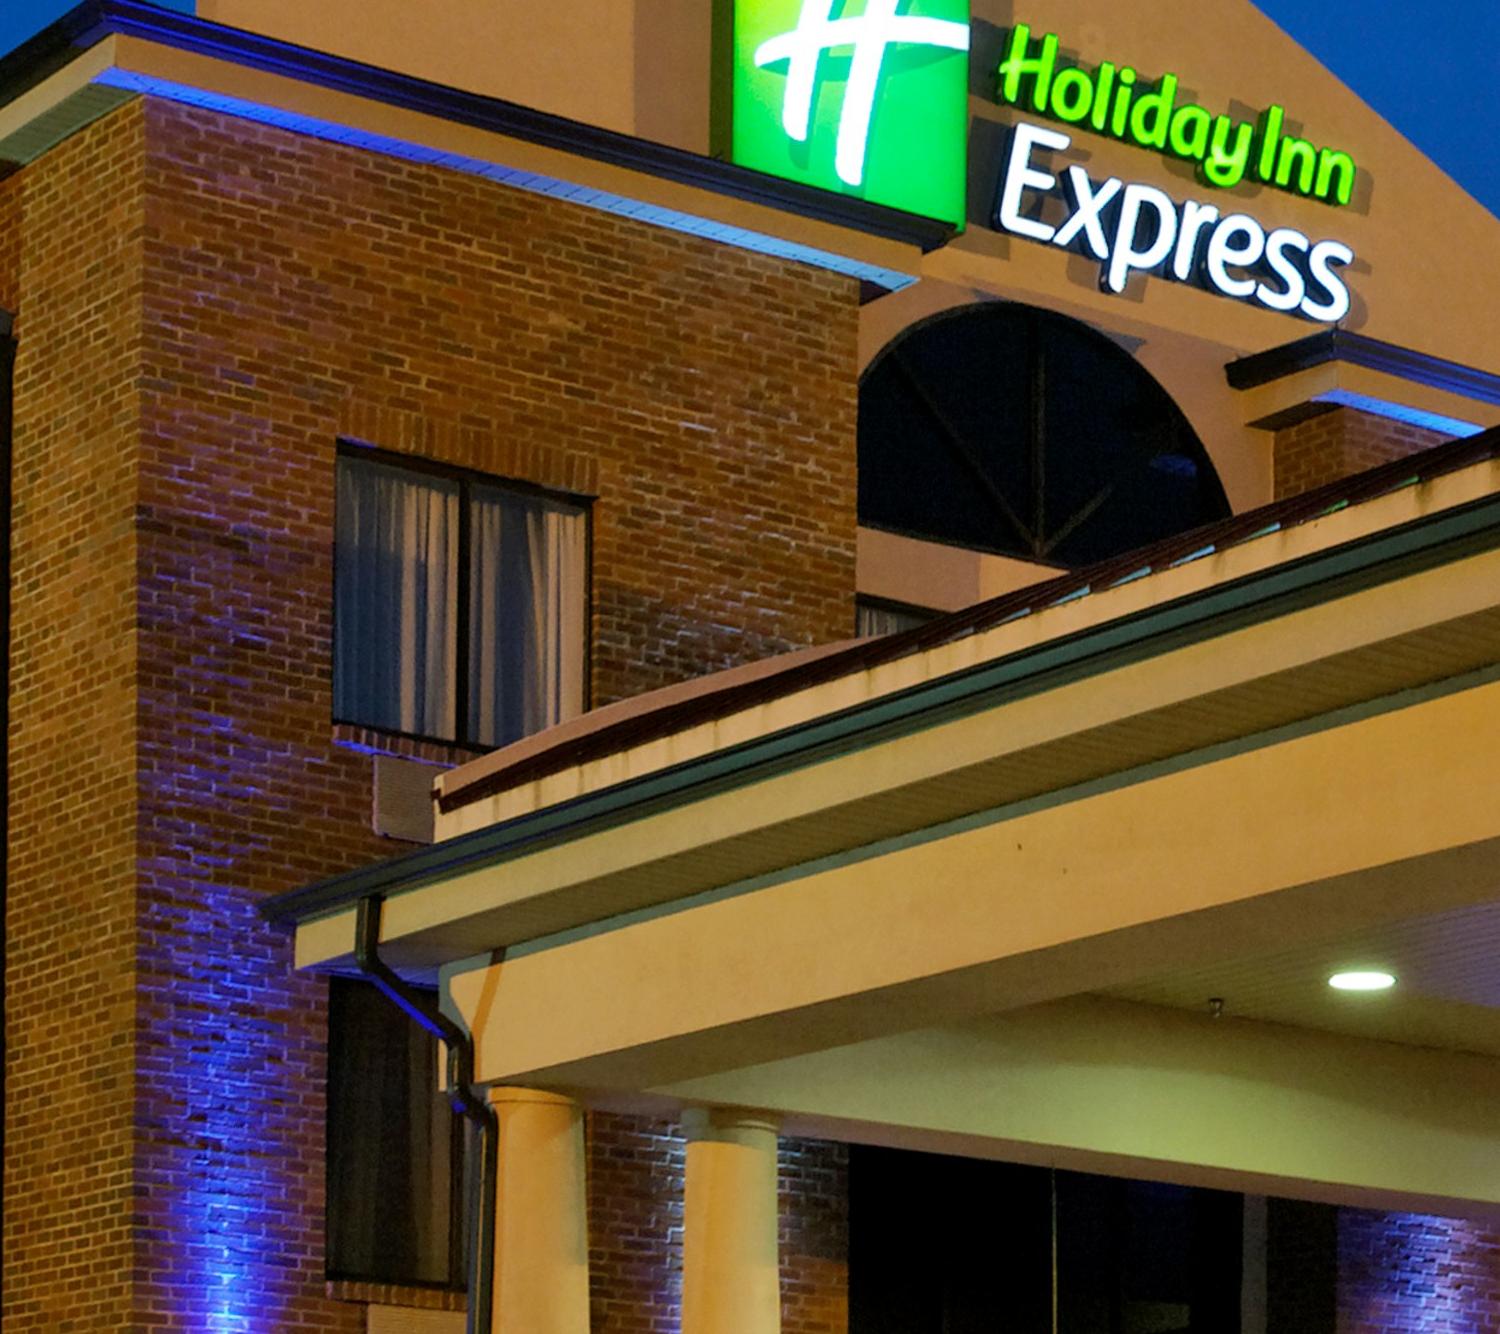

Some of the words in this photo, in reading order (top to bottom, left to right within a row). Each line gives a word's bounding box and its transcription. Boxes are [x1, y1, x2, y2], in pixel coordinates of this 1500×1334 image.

[997, 23, 1255, 188] Holiday
[1257, 104, 1356, 205] Inn
[999, 121, 1354, 323] Express
